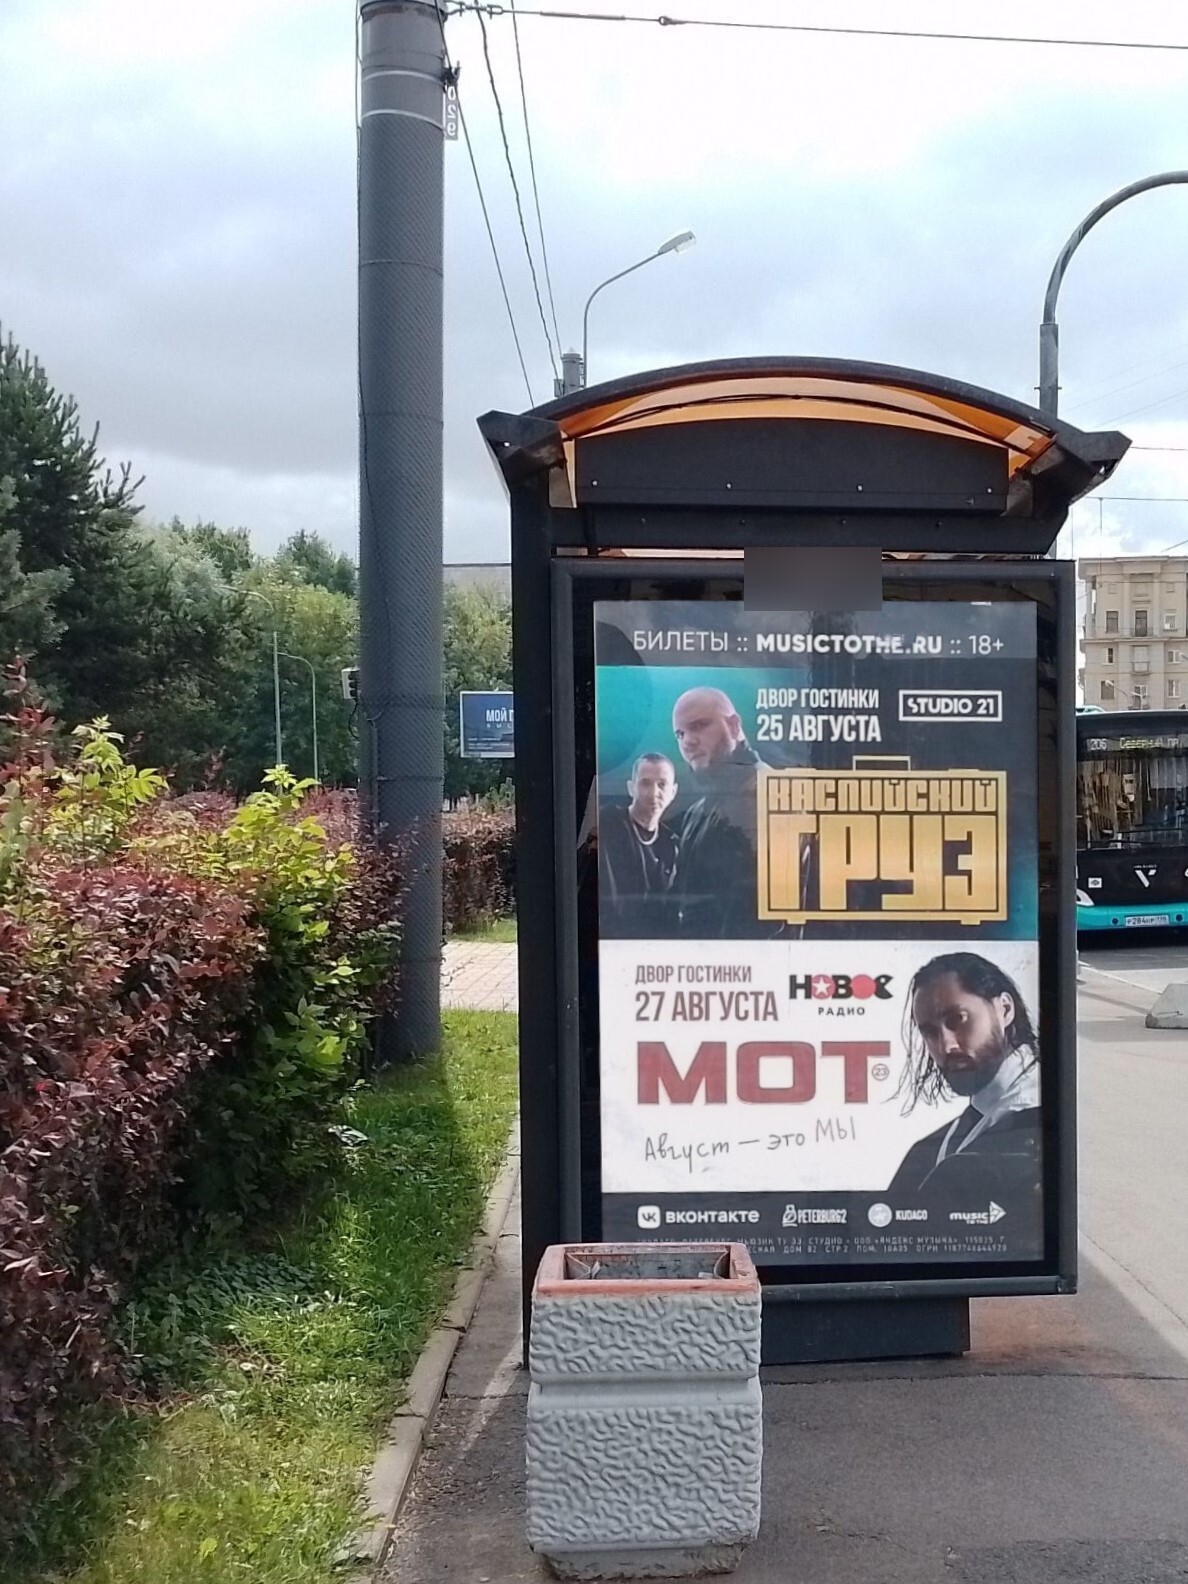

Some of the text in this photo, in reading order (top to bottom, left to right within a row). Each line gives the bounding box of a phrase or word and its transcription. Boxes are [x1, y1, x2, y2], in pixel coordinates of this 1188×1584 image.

[633, 630, 728, 652] БИЛЕТЫ
[756, 634, 942, 654] MUSICTOTHE.RU
[968, 634, 1004, 655] 18+
[756, 688, 879, 710] ДВОР ГОСТИНКИ
[907, 698, 994, 715] STUDIO 21
[756, 714, 882, 743] 25 АВГУСТА
[767, 778, 997, 812] КАСПИЙСКИЙ
[768, 813, 998, 911] ГРУЗ
[634, 964, 752, 985] ДВОР ГОСТИНКИ
[635, 991, 779, 1022] 27 АВГУСТА
[818, 1006, 866, 1017] РАДИО
[637, 1040, 891, 1106] МОТ
[644, 1132, 730, 1174] Август
[895, 1209, 928, 1221] KUDAGO
